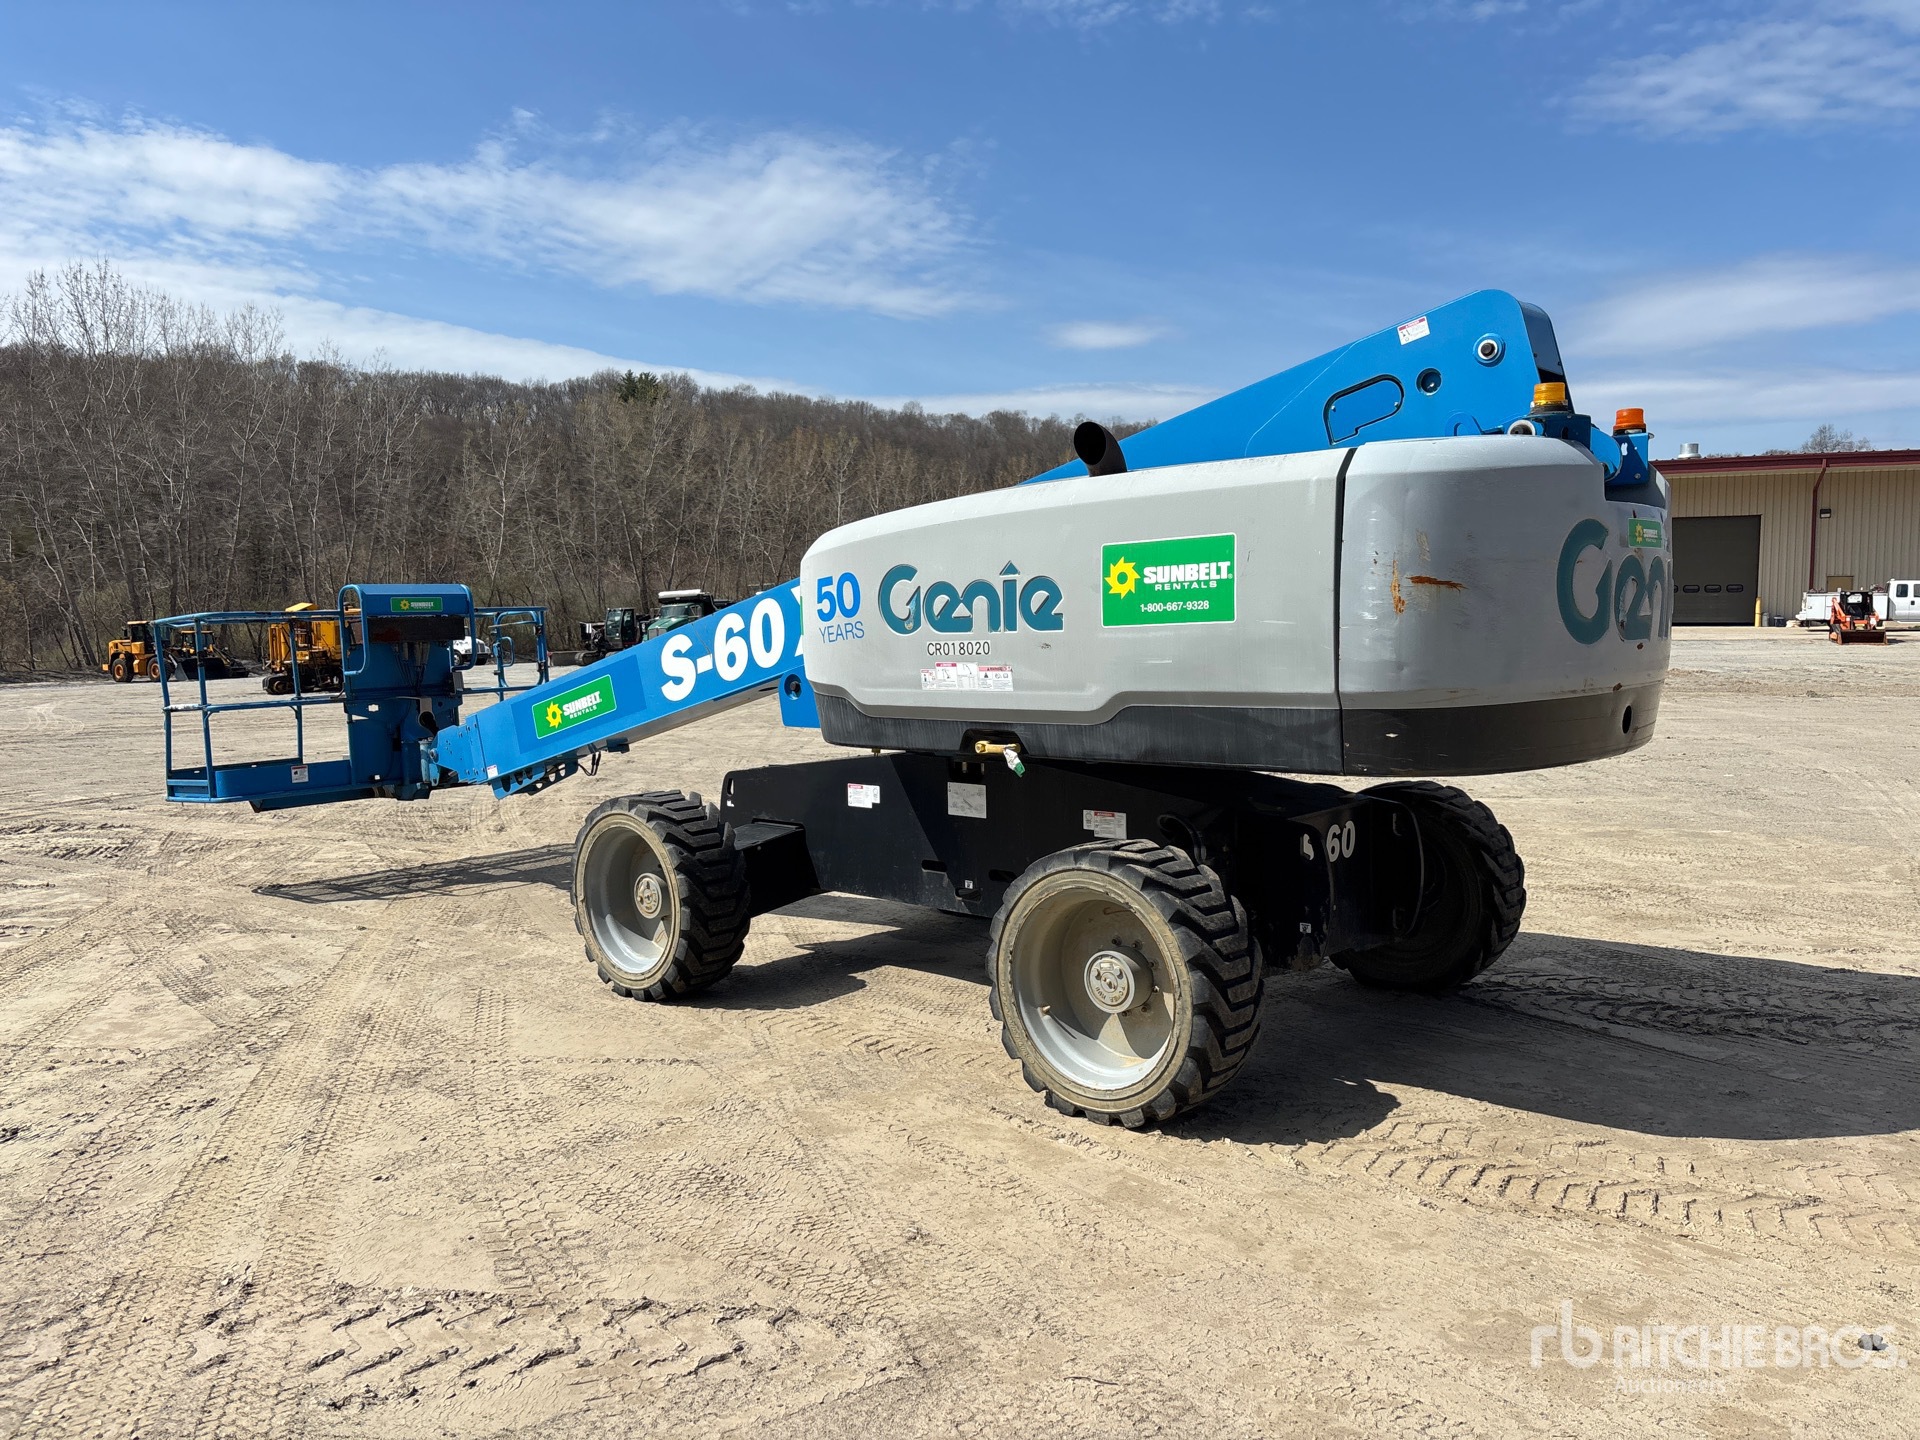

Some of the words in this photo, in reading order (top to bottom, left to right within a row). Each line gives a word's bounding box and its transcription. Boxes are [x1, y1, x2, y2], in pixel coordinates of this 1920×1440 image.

[1143, 561, 1231, 584] SUNBELT
[1155, 580, 1217, 591] RENTALS
[817, 572, 861, 622] 50
[878, 560, 1064, 635] Genie
[1140, 600, 1209, 612] 1-800-667-9328
[819, 621, 865, 643] YEARS
[661, 586, 804, 702] S-60
[927, 642, 990, 656] CR018020
[562, 691, 601, 716] SUNBELT
[569, 705, 597, 719] RENTALS
